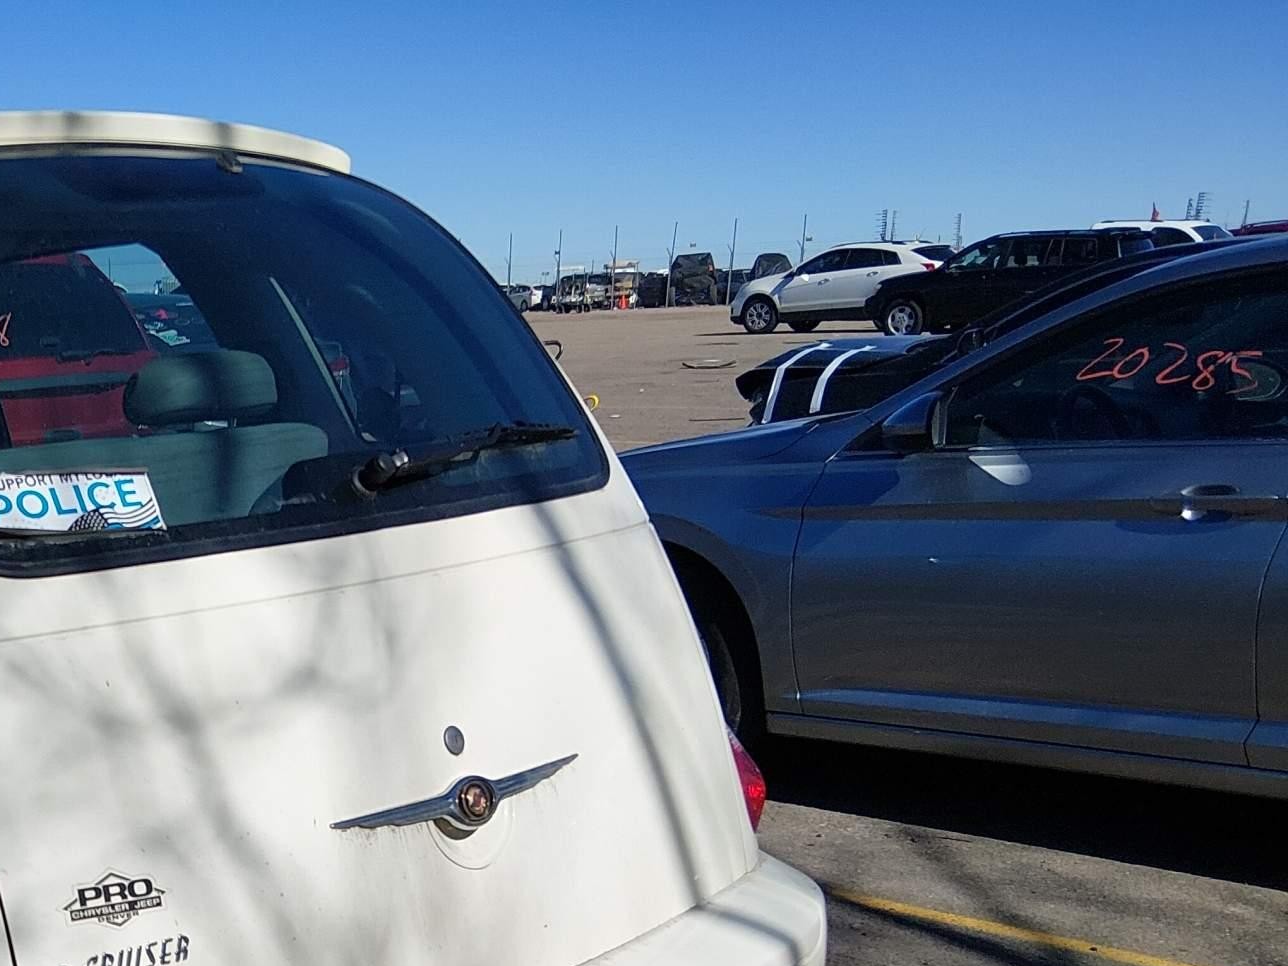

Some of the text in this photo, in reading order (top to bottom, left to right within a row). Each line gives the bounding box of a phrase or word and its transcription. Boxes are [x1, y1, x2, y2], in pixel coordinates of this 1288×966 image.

[1076, 338, 1263, 394] 20285
[77, 878, 153, 907] PRO
[71, 897, 161, 920] CHRYSLER JEEP
[98, 910, 140, 923] DENVER
